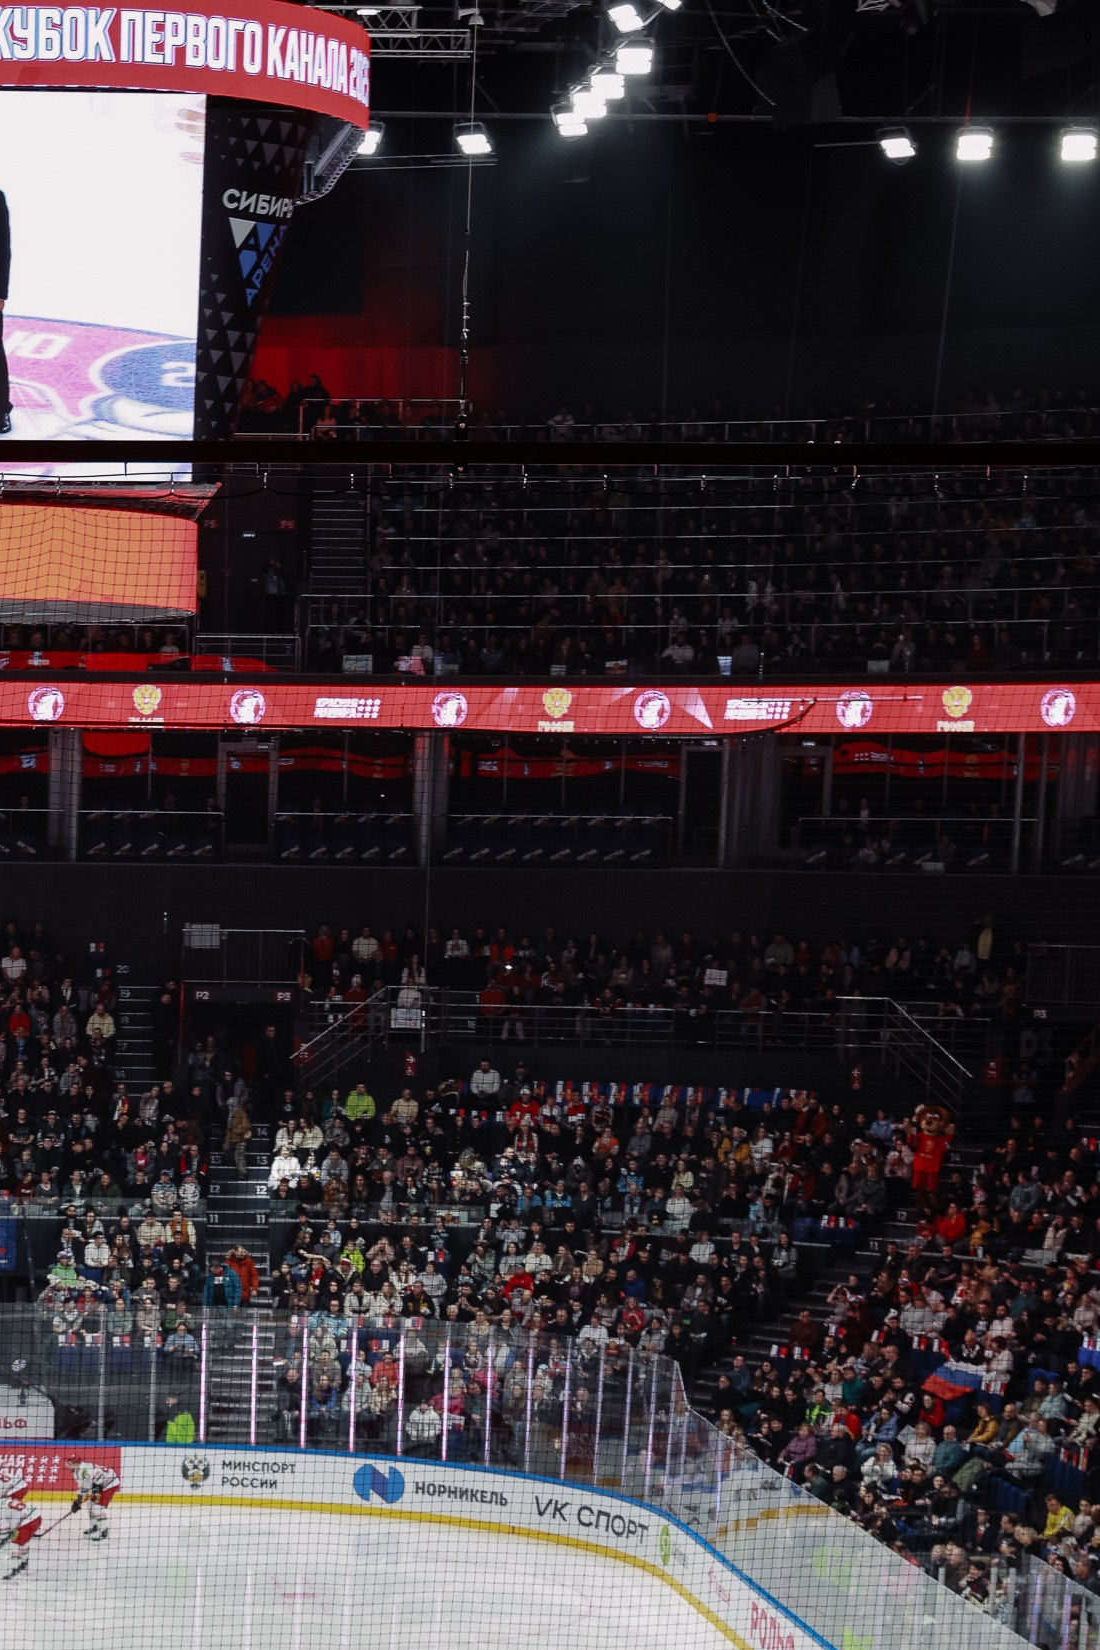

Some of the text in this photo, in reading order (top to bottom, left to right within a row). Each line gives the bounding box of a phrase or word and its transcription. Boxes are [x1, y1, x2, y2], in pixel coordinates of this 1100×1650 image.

[119, 10, 263, 75] ПЕРВОГО
[267, 24, 349, 96] КАНАЛА
[221, 1460, 296, 1475] МИНСПОРТ
[221, 1477, 278, 1490] РОССИИ
[414, 1481, 508, 1507] НОРНИКЕЛЬ
[535, 1496, 649, 1544] VK СПОРТ
